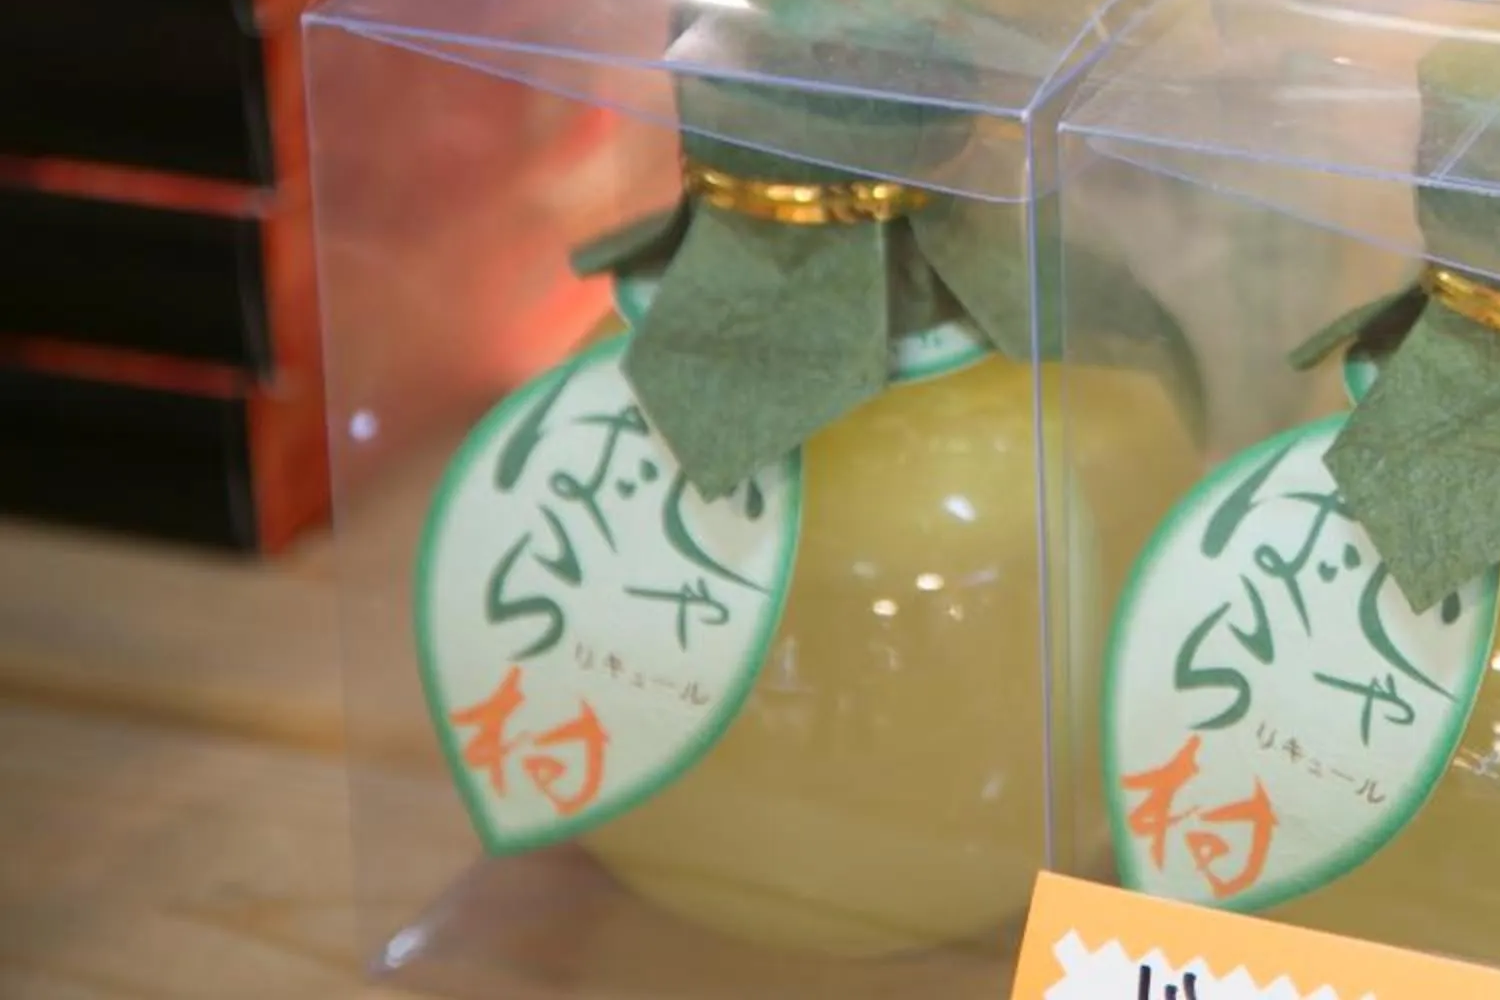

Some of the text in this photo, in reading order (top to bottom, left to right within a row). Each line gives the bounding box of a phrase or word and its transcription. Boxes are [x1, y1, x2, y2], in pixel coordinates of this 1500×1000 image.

[574, 642, 711, 705] リキュール
[1255, 721, 1387, 804] リキュール
